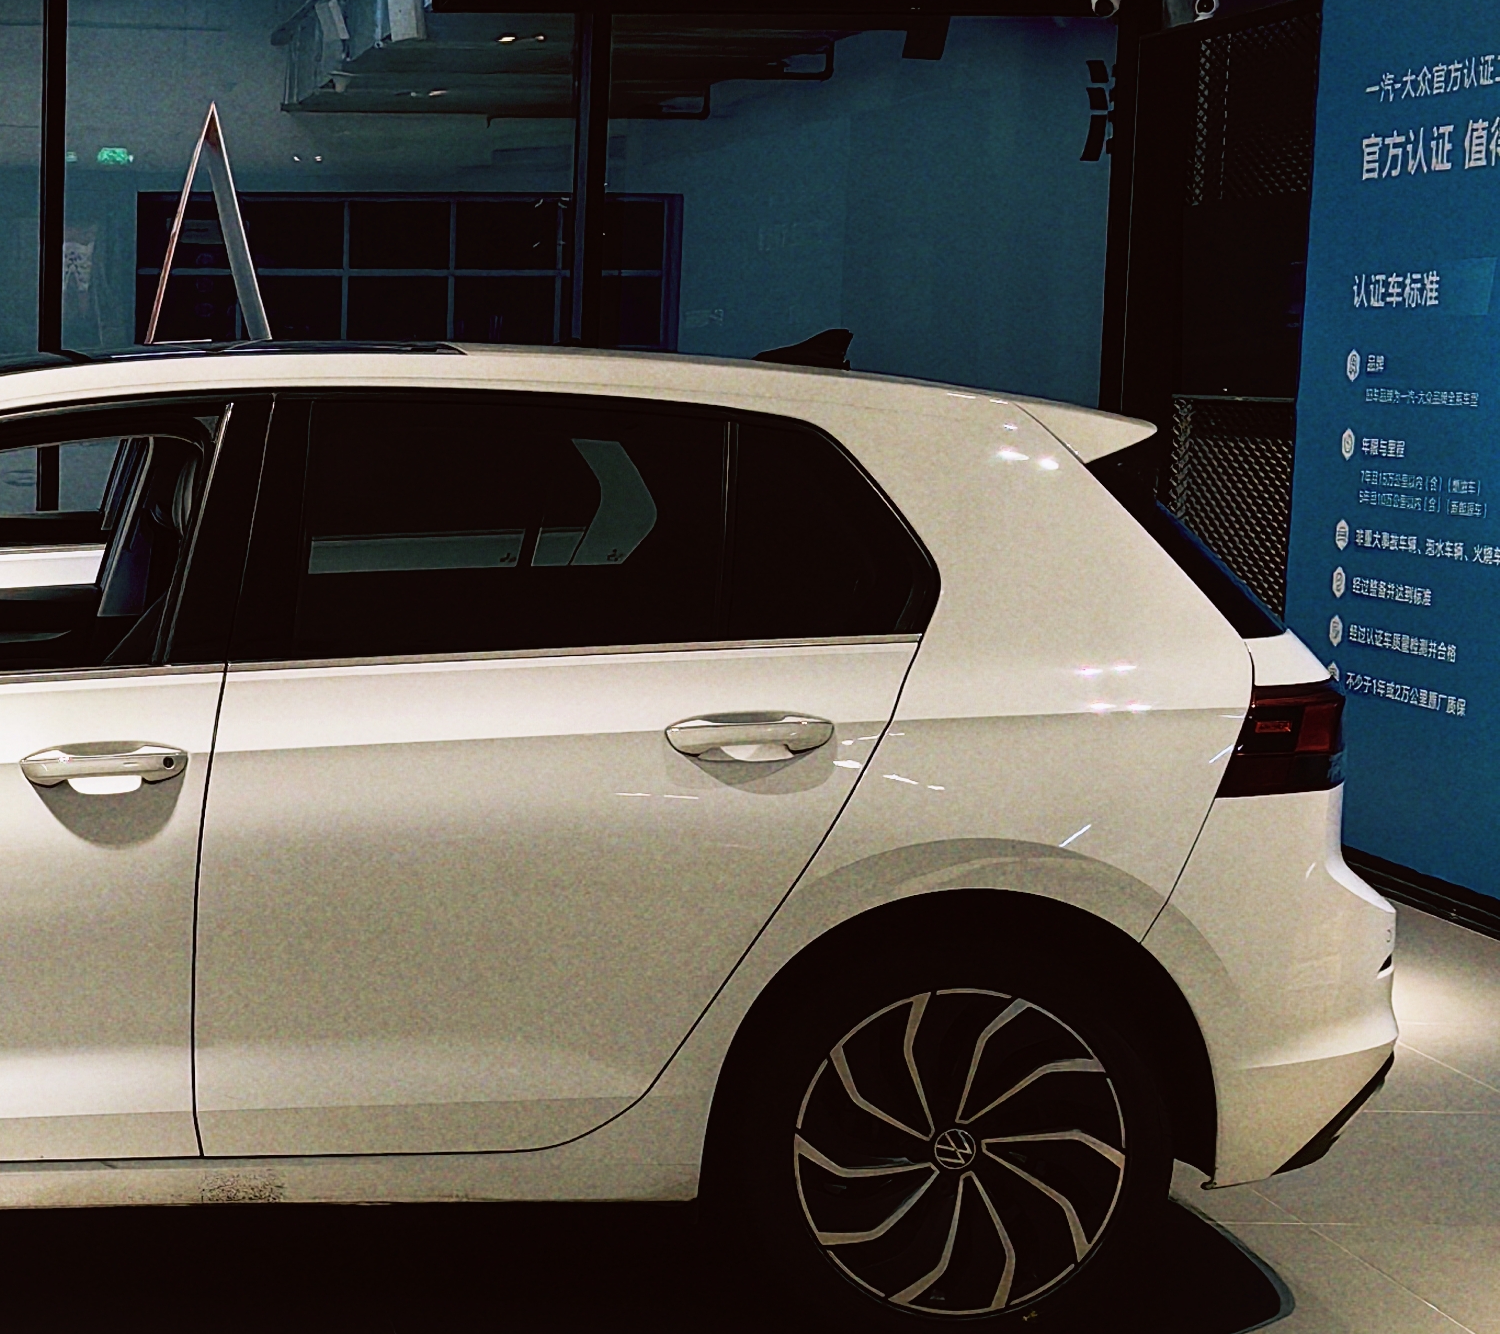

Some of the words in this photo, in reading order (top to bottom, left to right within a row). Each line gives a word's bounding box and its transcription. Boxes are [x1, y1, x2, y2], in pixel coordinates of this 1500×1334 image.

[1361, 123, 1455, 181] 官方认证
[1352, 270, 1441, 309] 认证车标准
[1361, 437, 1406, 458] 年限与里程
